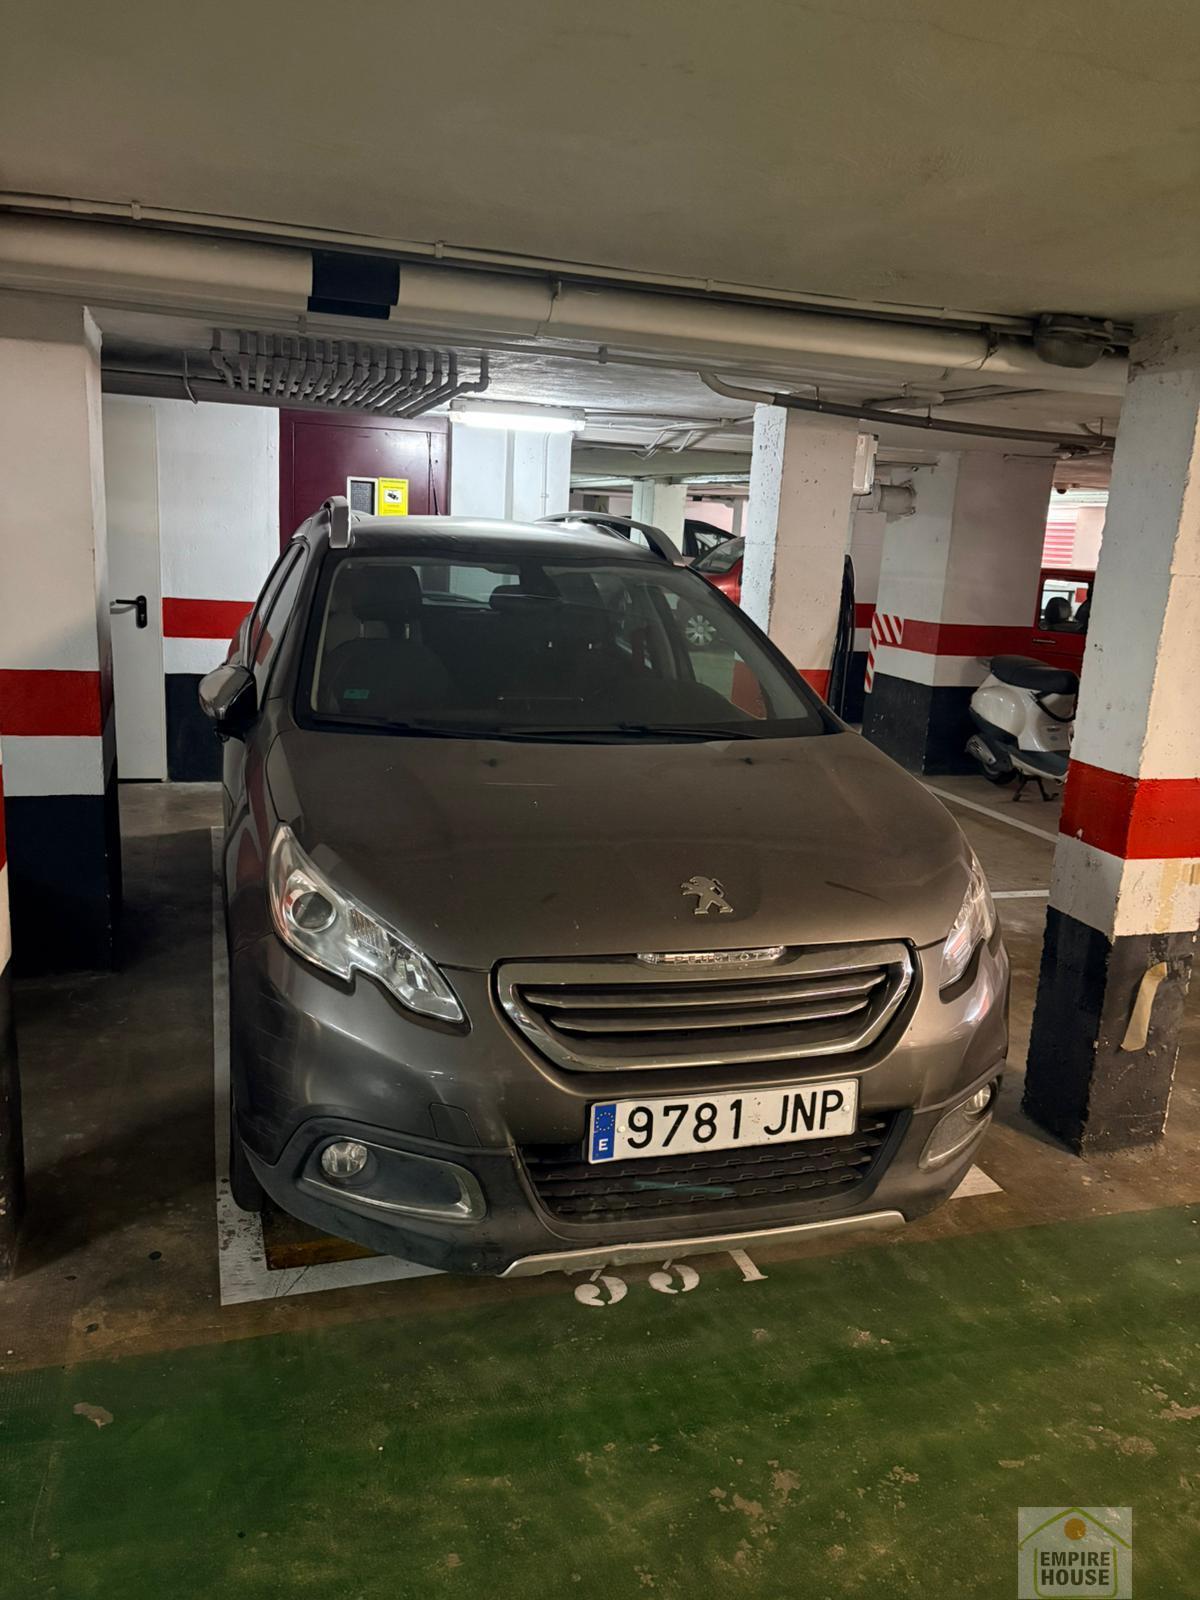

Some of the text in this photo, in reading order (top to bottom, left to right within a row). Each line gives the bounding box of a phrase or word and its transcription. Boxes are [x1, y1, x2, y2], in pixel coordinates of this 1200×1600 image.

[598, 1089, 844, 1151] E 9781 JNP
